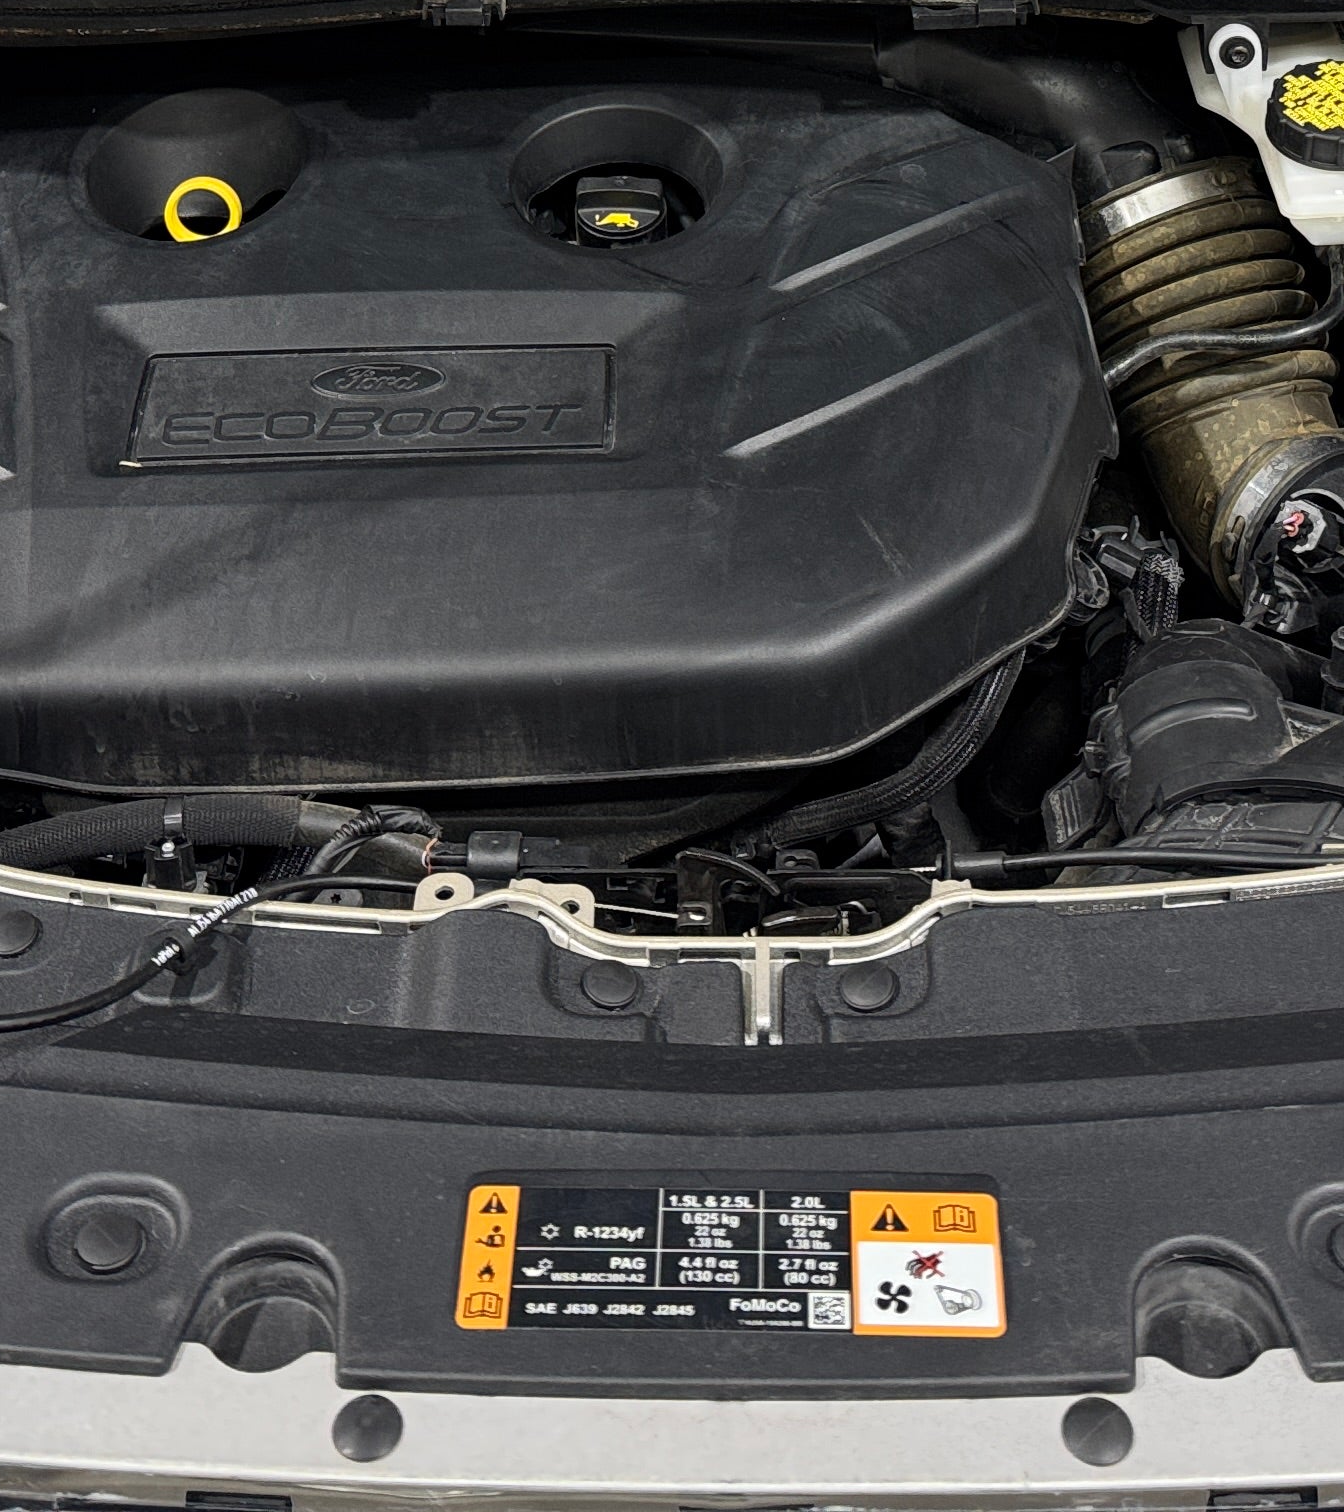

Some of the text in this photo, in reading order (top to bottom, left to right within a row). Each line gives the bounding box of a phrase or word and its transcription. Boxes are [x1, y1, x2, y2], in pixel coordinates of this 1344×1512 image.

[332, 363, 423, 395] Ford
[669, 1195, 755, 1209] 1.5L & 2.5L
[790, 1196, 826, 1209] 2.0L
[681, 1213, 741, 1229] 0.625 kg
[778, 1214, 838, 1230] 0.625 kg
[574, 1225, 646, 1243] R-1234yf
[694, 1226, 728, 1237] 22 oz
[792, 1227, 825, 1238] 22 oz
[688, 1237, 734, 1249] 1.38 lbs
[785, 1239, 832, 1250] 1.38 lbs
[609, 1256, 648, 1270] PAG
[678, 1256, 739, 1270] 4.4 fl oz
[778, 1258, 840, 1271] 2.7 fl oz
[679, 1270, 741, 1285] (130 cc)
[784, 1271, 837, 1287] (80 cc)
[524, 1302, 558, 1315] SAE
[562, 1302, 599, 1315] J639
[729, 1298, 802, 1313] FoMoCo
